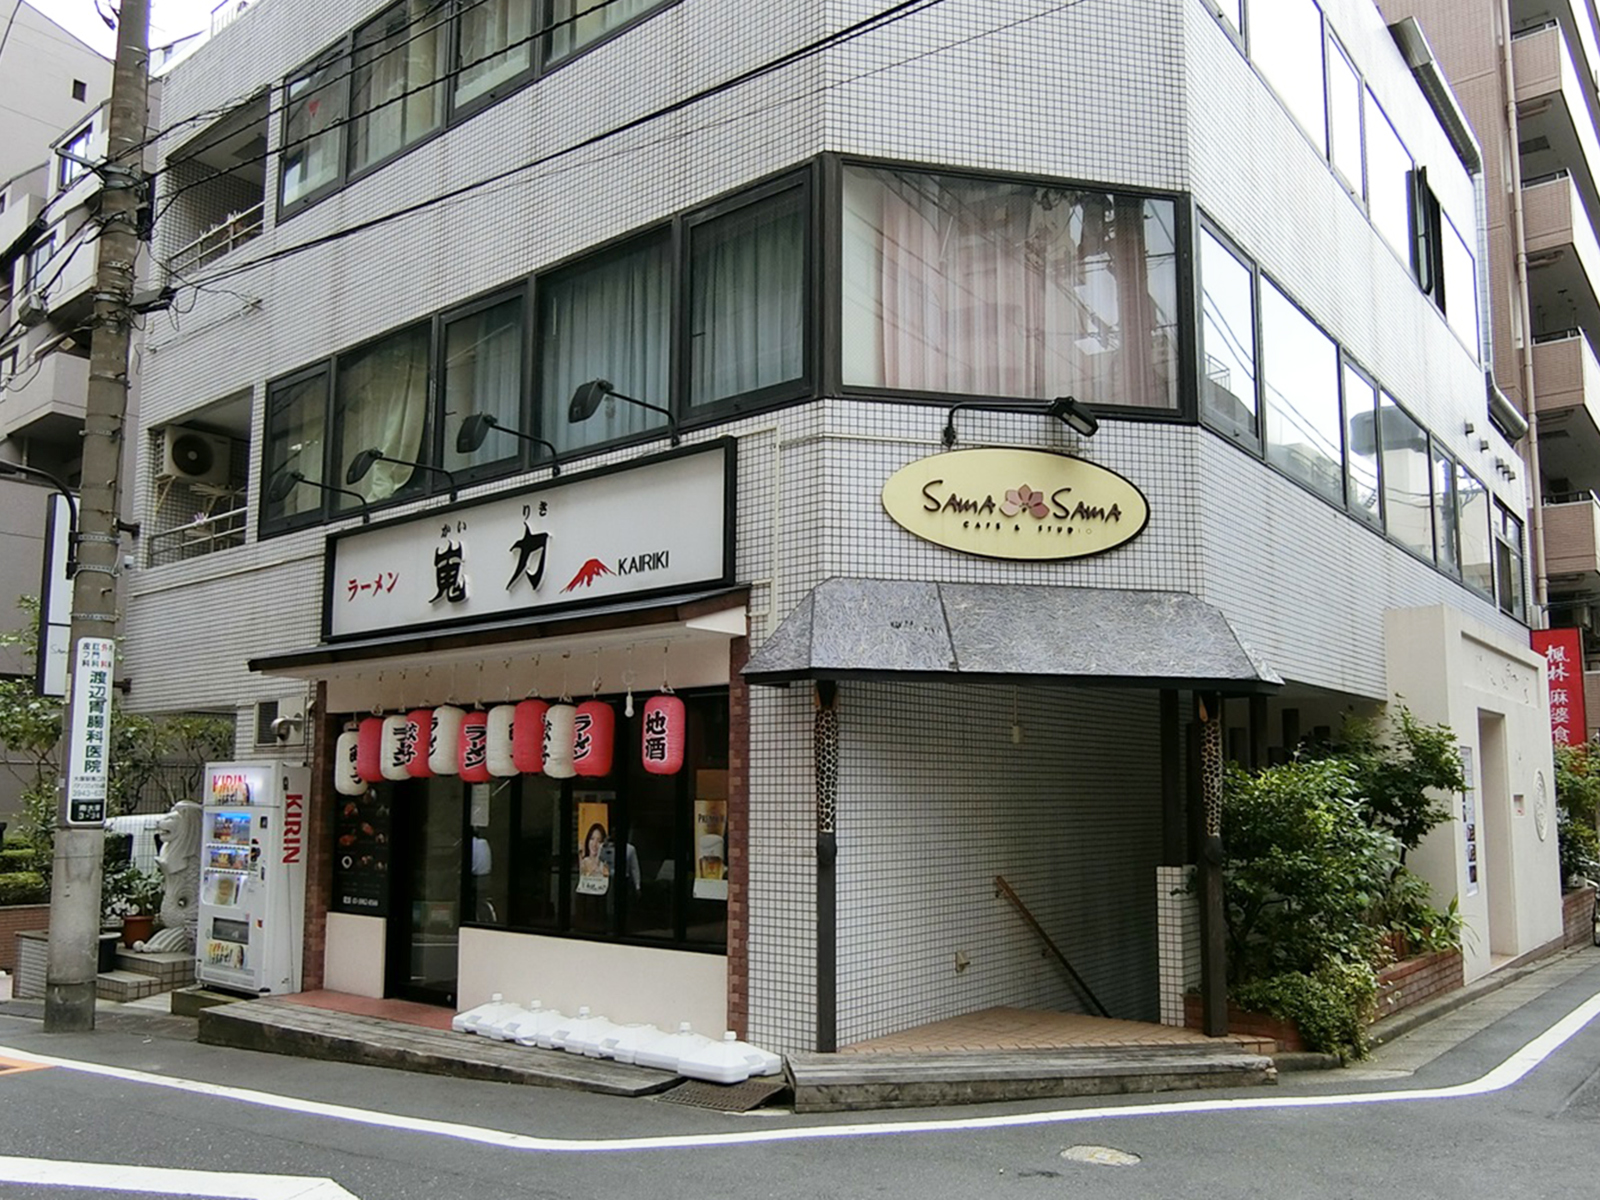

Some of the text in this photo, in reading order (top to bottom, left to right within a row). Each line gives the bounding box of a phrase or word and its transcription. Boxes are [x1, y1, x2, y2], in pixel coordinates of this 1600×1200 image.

[440, 501, 548, 538] かい りき
[618, 550, 670, 577] KAIRIKI
[346, 570, 400, 603] ラーメン
[84, 670, 108, 774] 渡辺胃腸科医院
[644, 710, 667, 762] 地酒
[464, 725, 486, 768] ラーメン
[283, 794, 303, 864] KIRIN
